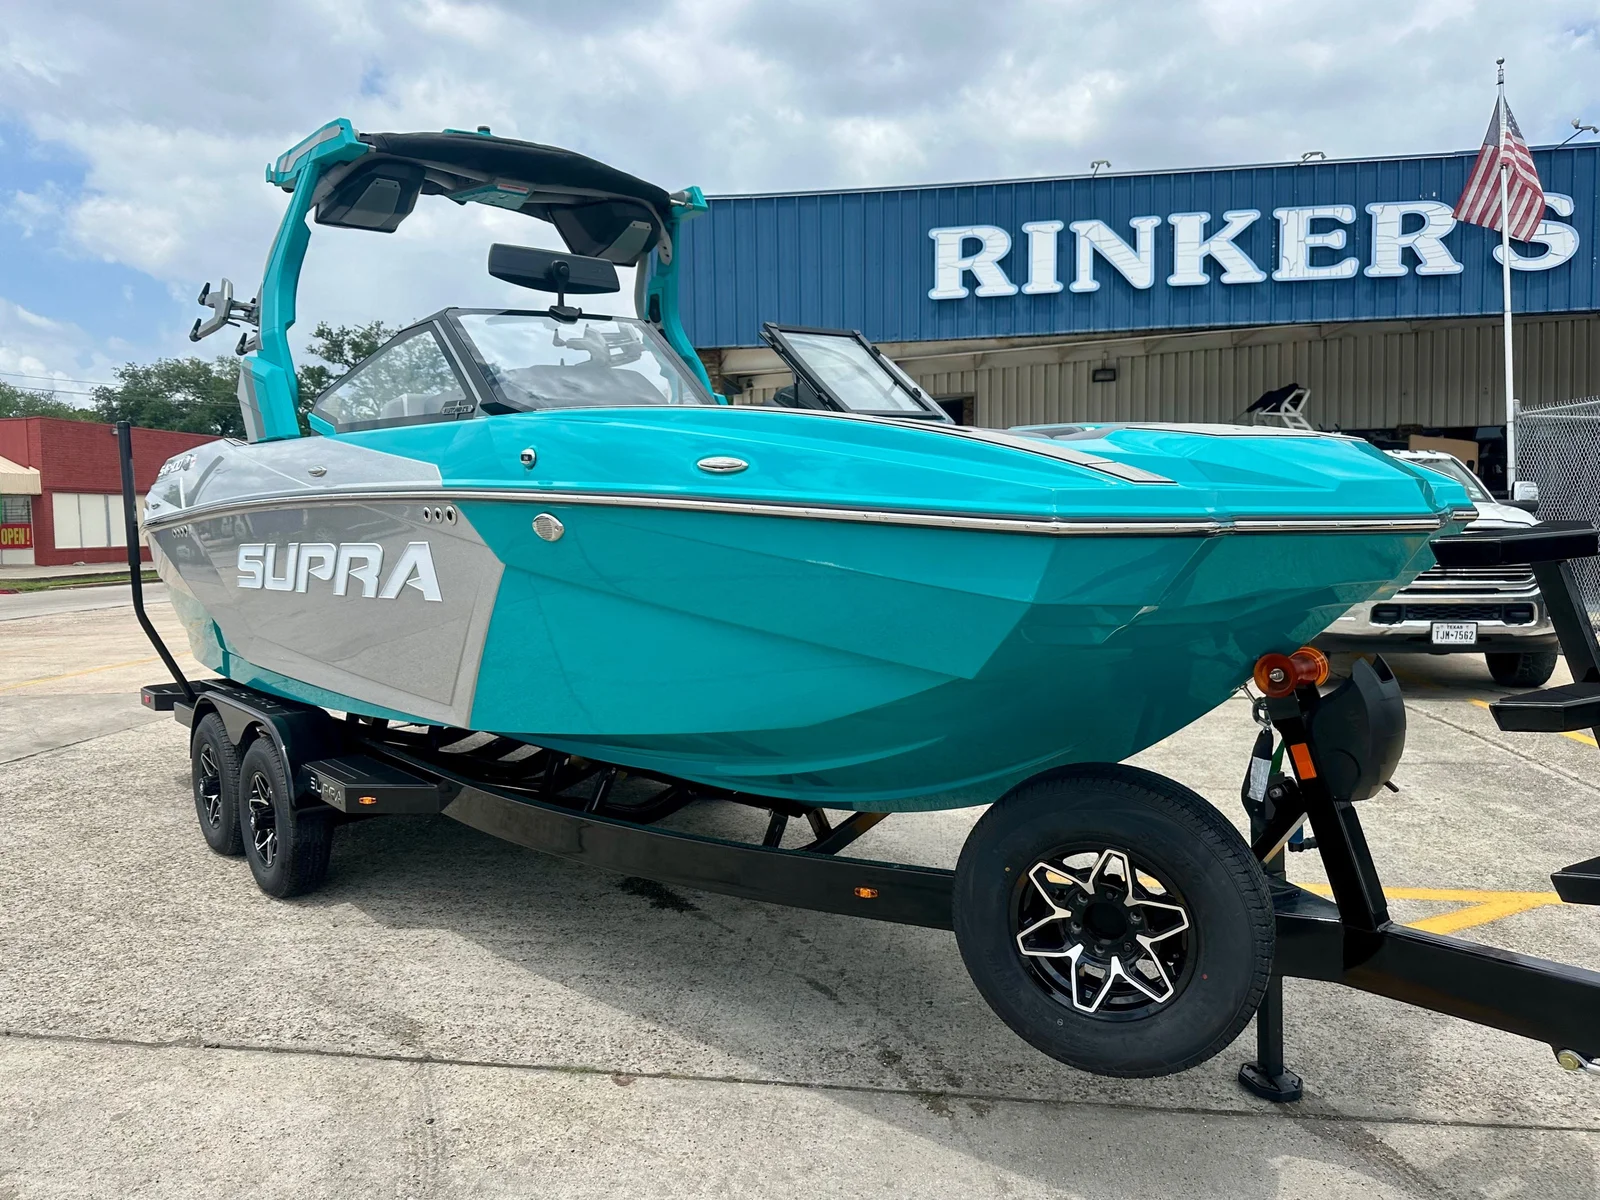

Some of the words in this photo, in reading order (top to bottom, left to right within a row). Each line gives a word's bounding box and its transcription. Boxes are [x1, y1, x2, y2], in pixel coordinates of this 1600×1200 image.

[928, 191, 1580, 300] RINKERS
[236, 541, 443, 602] SUPRA
[310, 776, 342, 804] SUPRA
